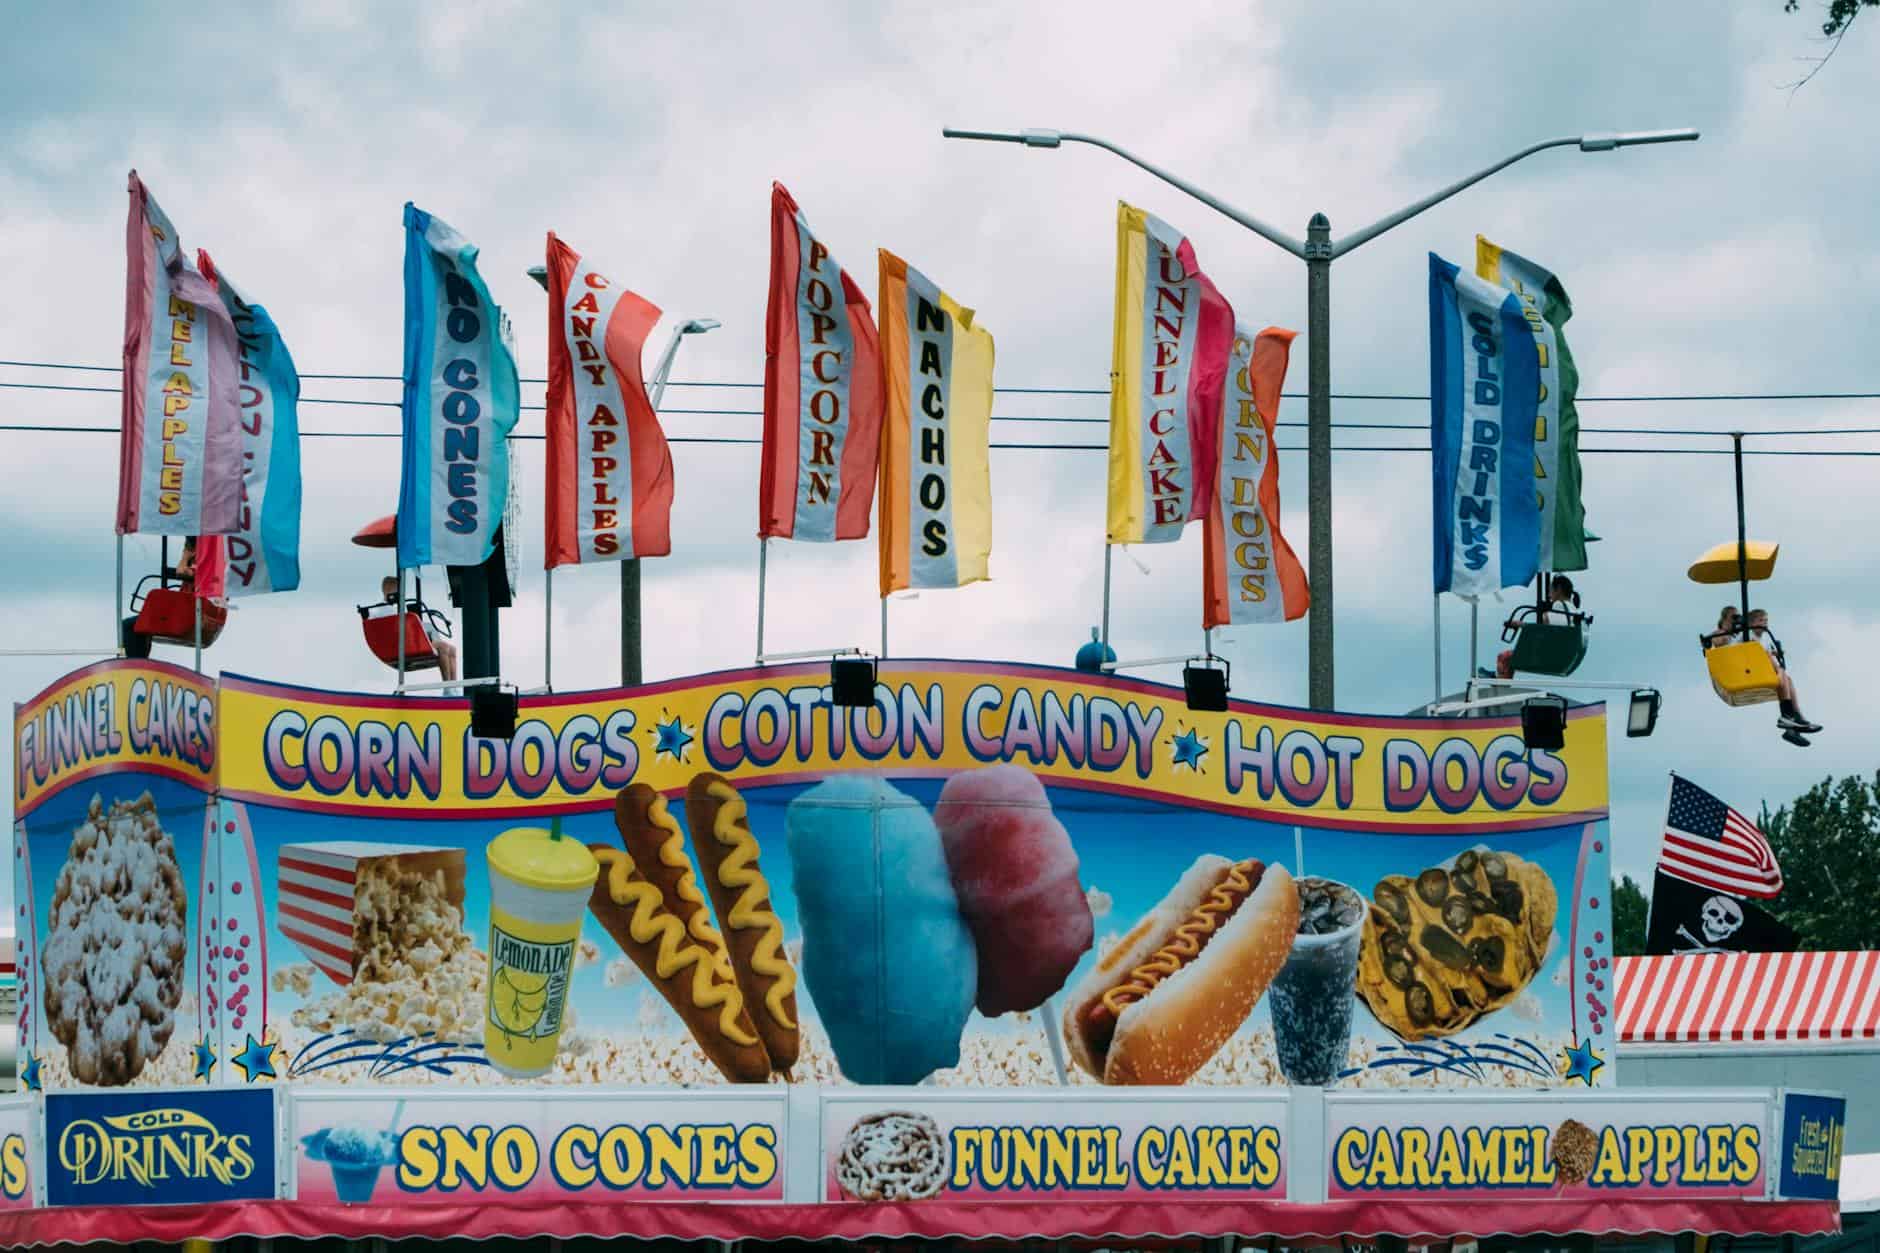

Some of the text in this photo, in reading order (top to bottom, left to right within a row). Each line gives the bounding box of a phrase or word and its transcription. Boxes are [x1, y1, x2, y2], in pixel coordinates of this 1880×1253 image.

[570, 272, 620, 556] CANDY APPLES
[806, 238, 842, 505] POPCORN
[916, 296, 948, 558] NACHOS
[1148, 245, 1188, 526] UNNEL CAKE
[158, 370, 193, 516] APPLES
[442, 358, 481, 535] CONES
[1458, 311, 1501, 571] COLD DRINKS
[1231, 476, 1269, 602] DOGS
[19, 677, 216, 801] FUNNEL CAKES
[263, 682, 1568, 814] CORN DOGS COTTON CANDY HOT DOGS
[59, 1118, 256, 1189] DRINKS
[127, 1111, 185, 1130] COLD
[396, 1123, 778, 1192] SNO CONES
[949, 1124, 1282, 1191] FUNNEL CAKES
[1332, 1125, 1560, 1191] CARAMEL
[1588, 1125, 1761, 1189] APPLES
